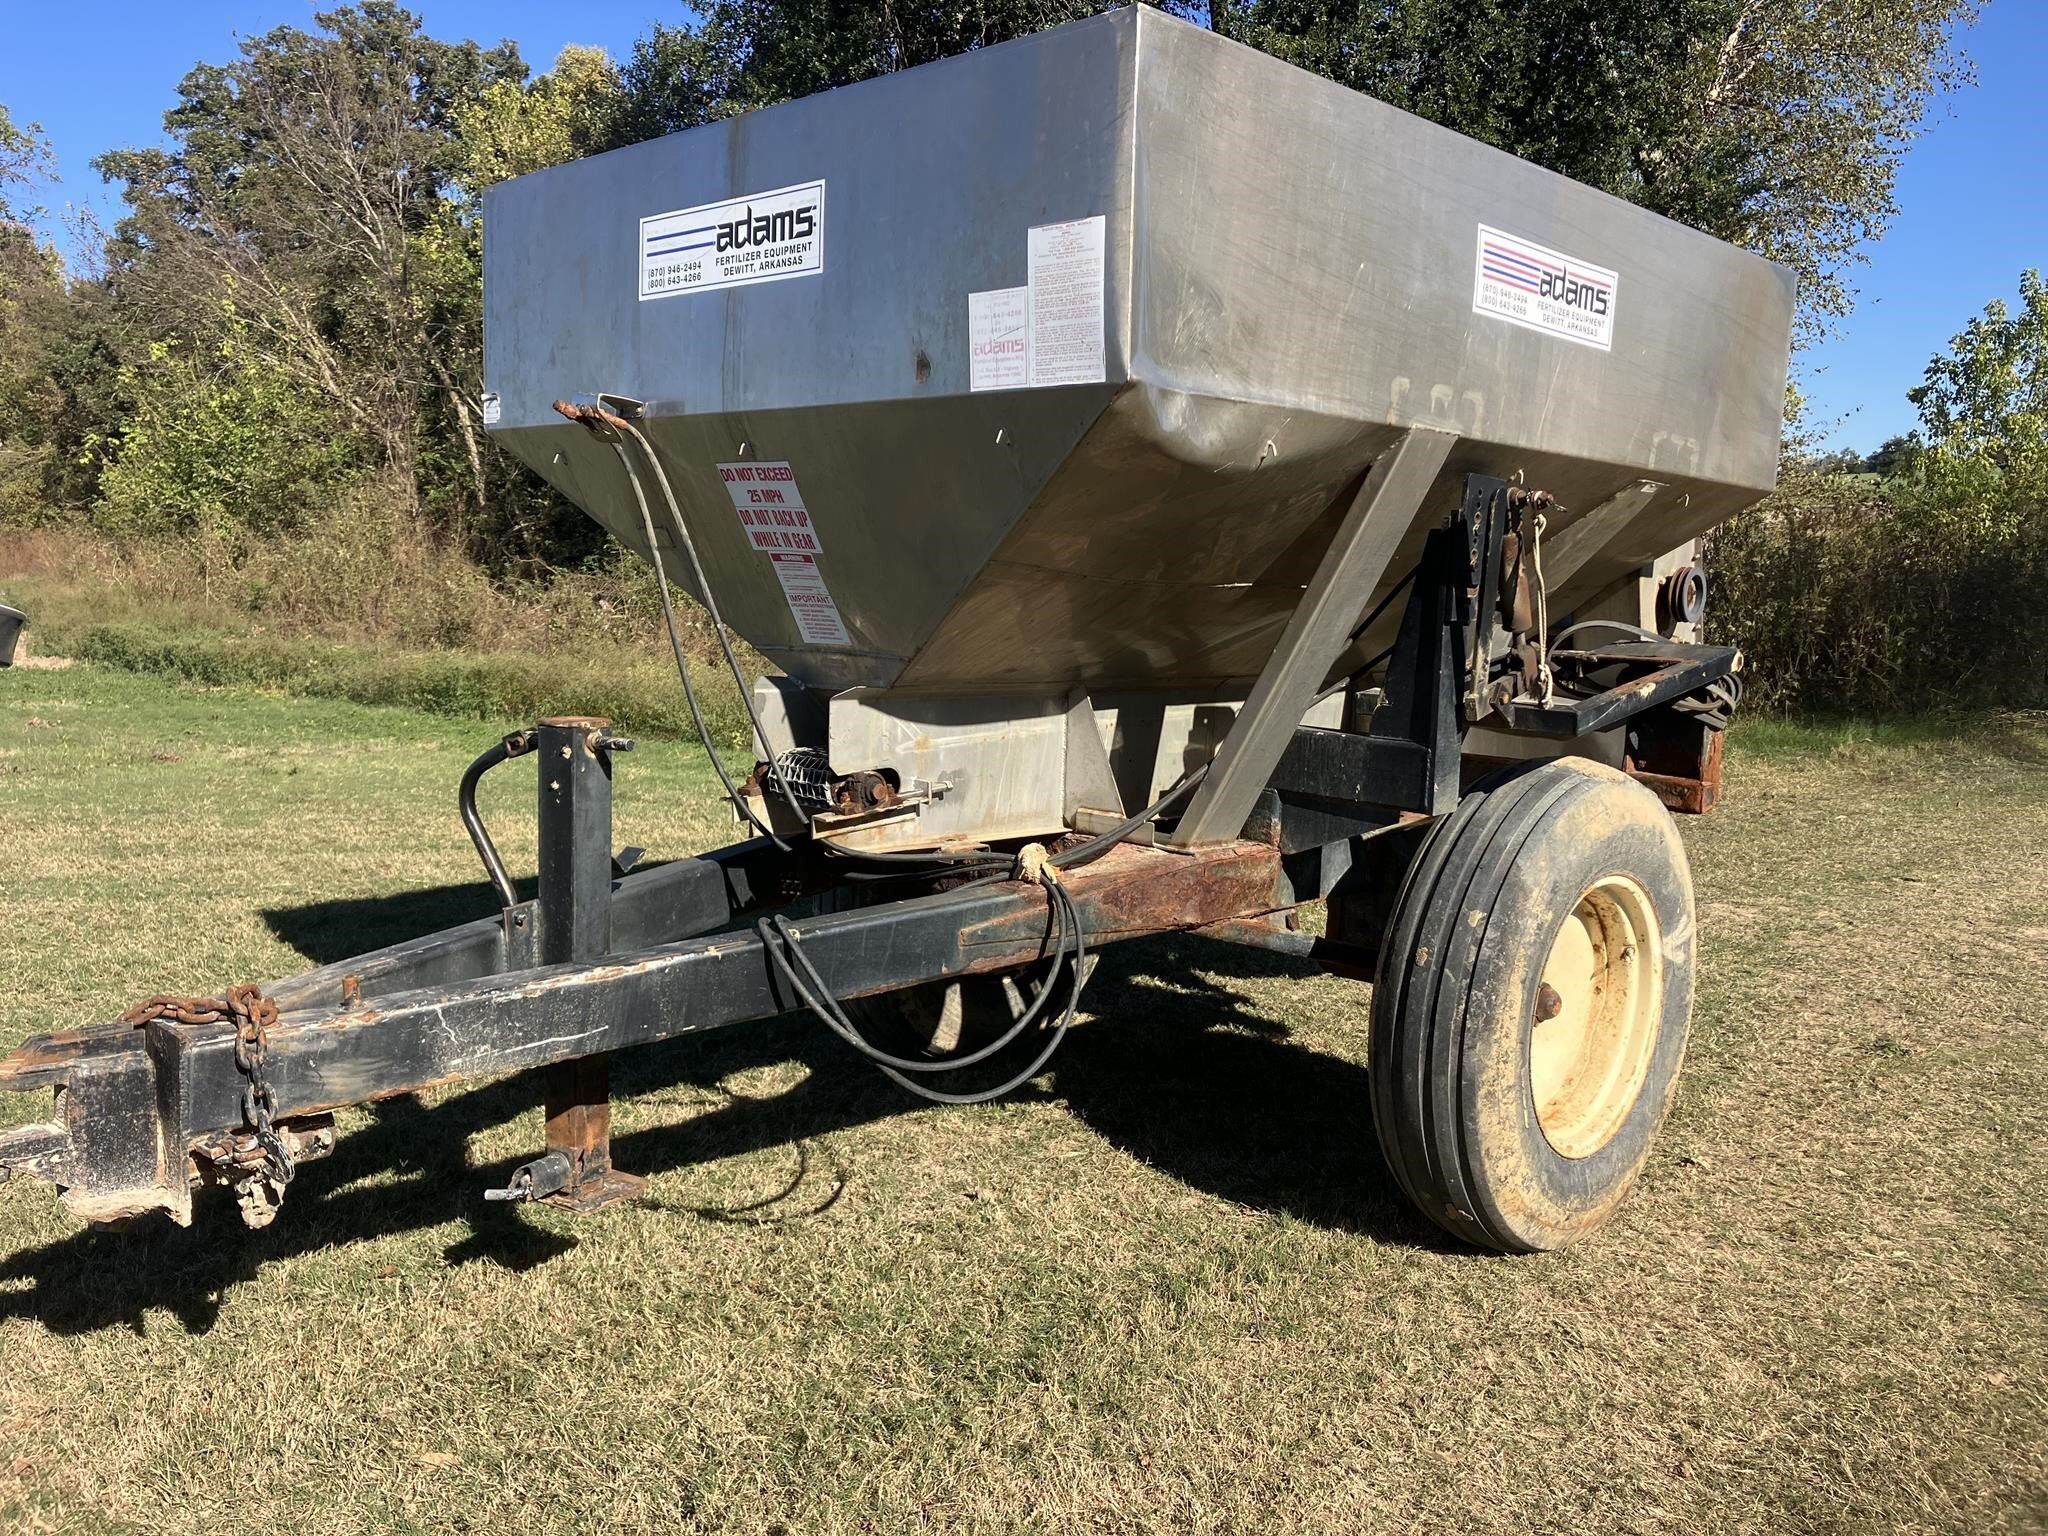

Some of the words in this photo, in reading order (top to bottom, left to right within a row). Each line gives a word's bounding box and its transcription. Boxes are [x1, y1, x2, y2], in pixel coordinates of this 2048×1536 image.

[716, 204, 813, 252] adams
[715, 251, 761, 267] FERTILIZER
[764, 241, 812, 258] EQUIPMENT
[647, 266, 666, 279] (870)
[667, 261, 702, 275] 946-2494
[723, 263, 756, 277] DEWITT,
[758, 255, 803, 271] ARKANSAS
[647, 277, 666, 289] (800)
[667, 272, 702, 286] 643-4266
[1539, 263, 1608, 316] adams
[1537, 300, 1570, 319] FERTILIZER
[1571, 312, 1606, 328] EQUIPMENT
[1567, 321, 1598, 337] ARKANSAS
[974, 337, 1025, 356] adams
[720, 468, 736, 481] DO
[734, 467, 756, 481] NOT
[755, 466, 793, 481] EXCEED
[747, 489, 762, 503] 25
[761, 489, 785, 503] MPH
[739, 509, 754, 526] DO
[752, 509, 773, 526] NOT
[771, 510, 797, 527] BACK
[794, 511, 808, 528] UP
[751, 531, 782, 548] WHILE
[780, 532, 793, 548] IN
[791, 532, 816, 550] GEAR
[788, 594, 831, 604] IMPORTANT
